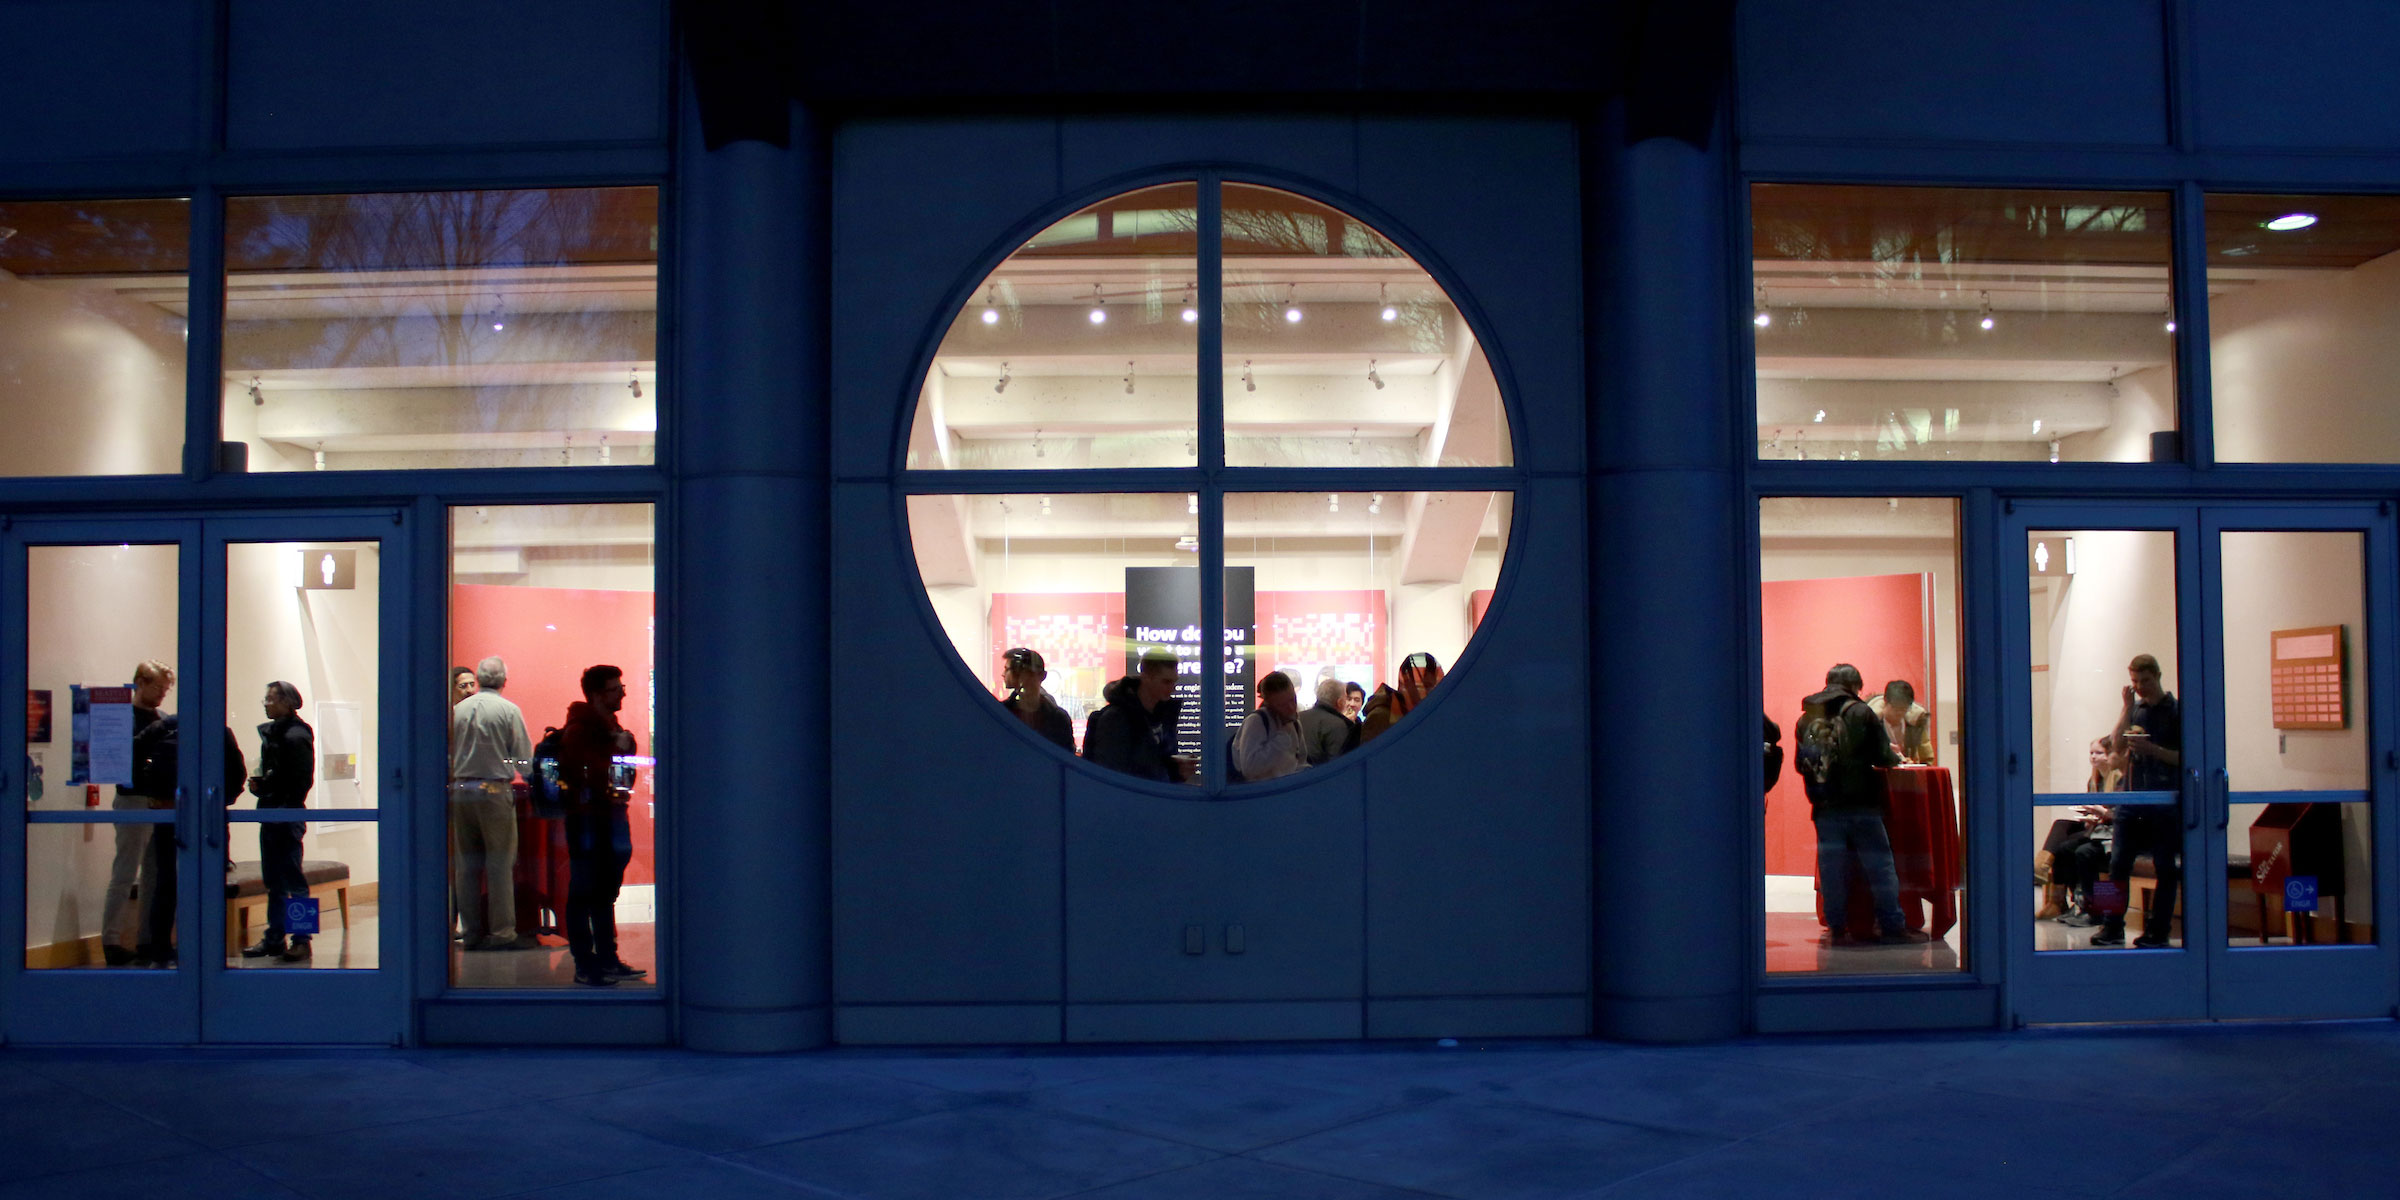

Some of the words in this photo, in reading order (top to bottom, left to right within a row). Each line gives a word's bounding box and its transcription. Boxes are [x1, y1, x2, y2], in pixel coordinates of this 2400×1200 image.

[1136, 626, 1177, 641] How
[1223, 628, 1245, 641] ou
[1175, 644, 1192, 656] to
[1234, 645, 1245, 656] a
